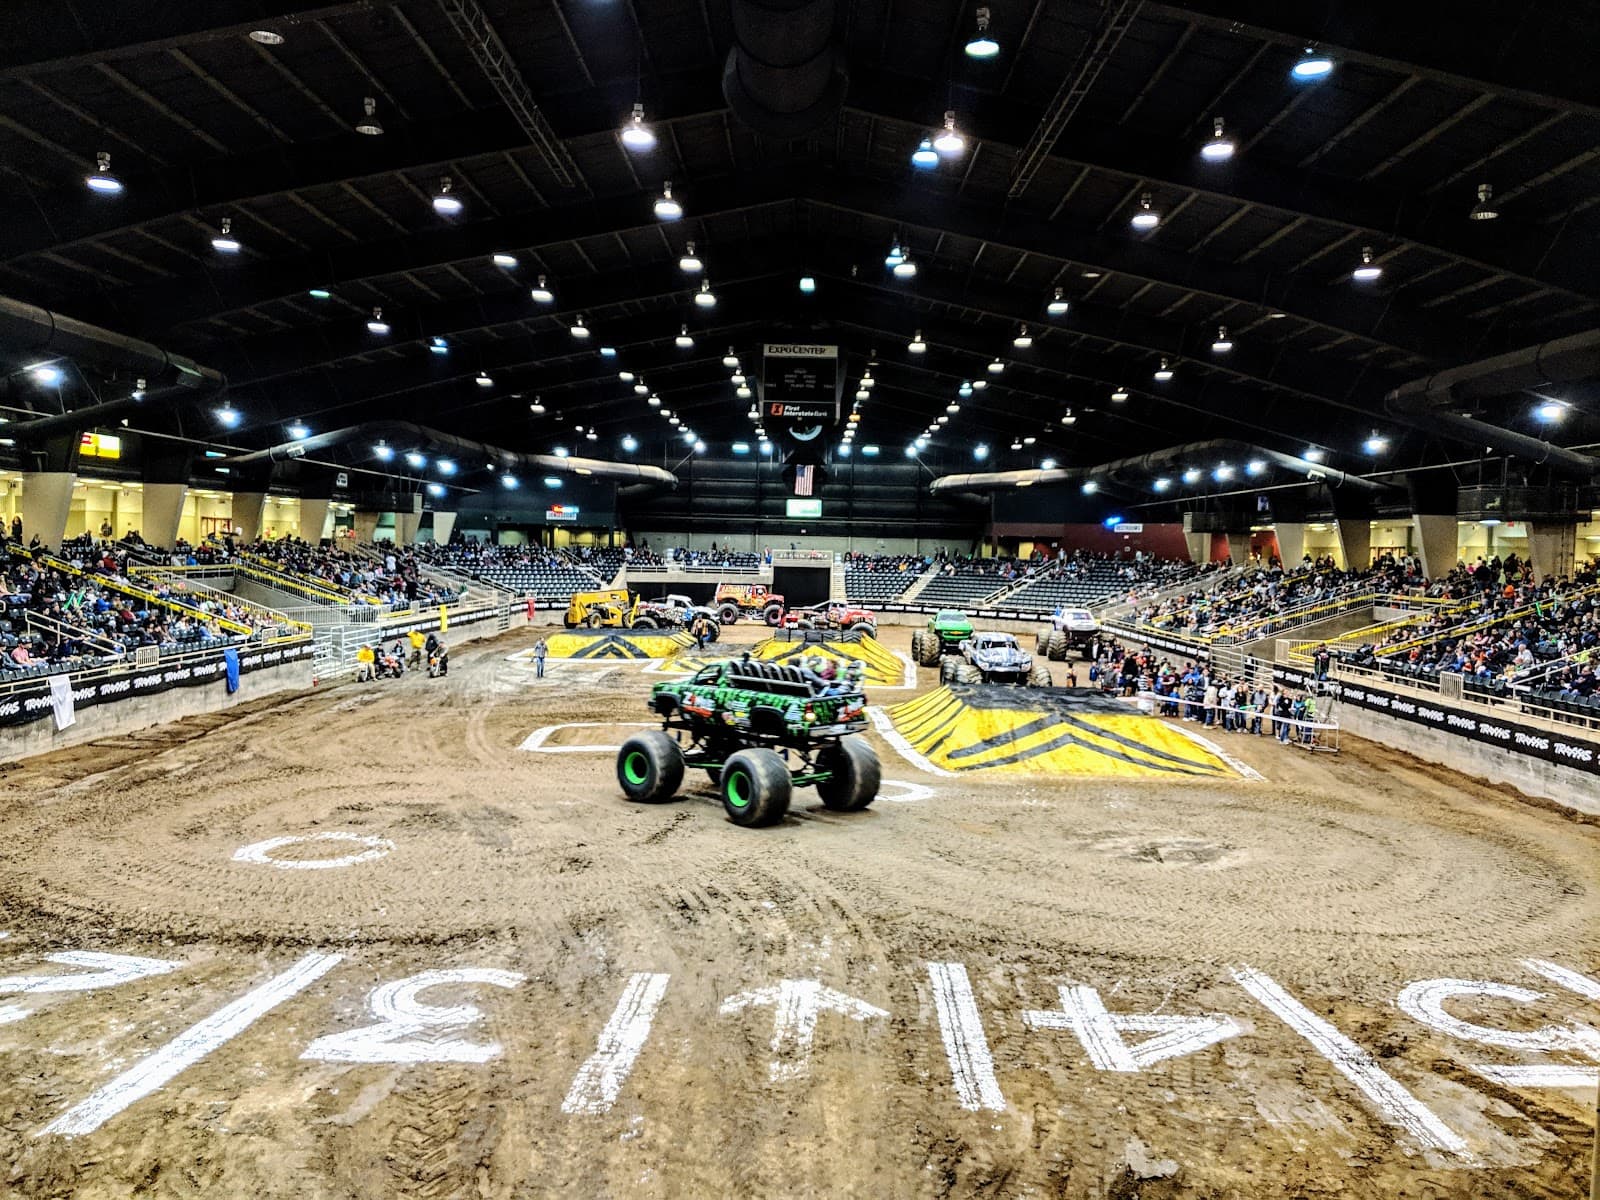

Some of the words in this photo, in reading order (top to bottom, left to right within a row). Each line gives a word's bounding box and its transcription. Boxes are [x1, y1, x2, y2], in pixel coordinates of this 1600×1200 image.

[1479, 722, 1511, 740] TRAXXAS
[1514, 732, 1550, 750] TRAXXAS
[1553, 742, 1593, 762] TRAXXAS
